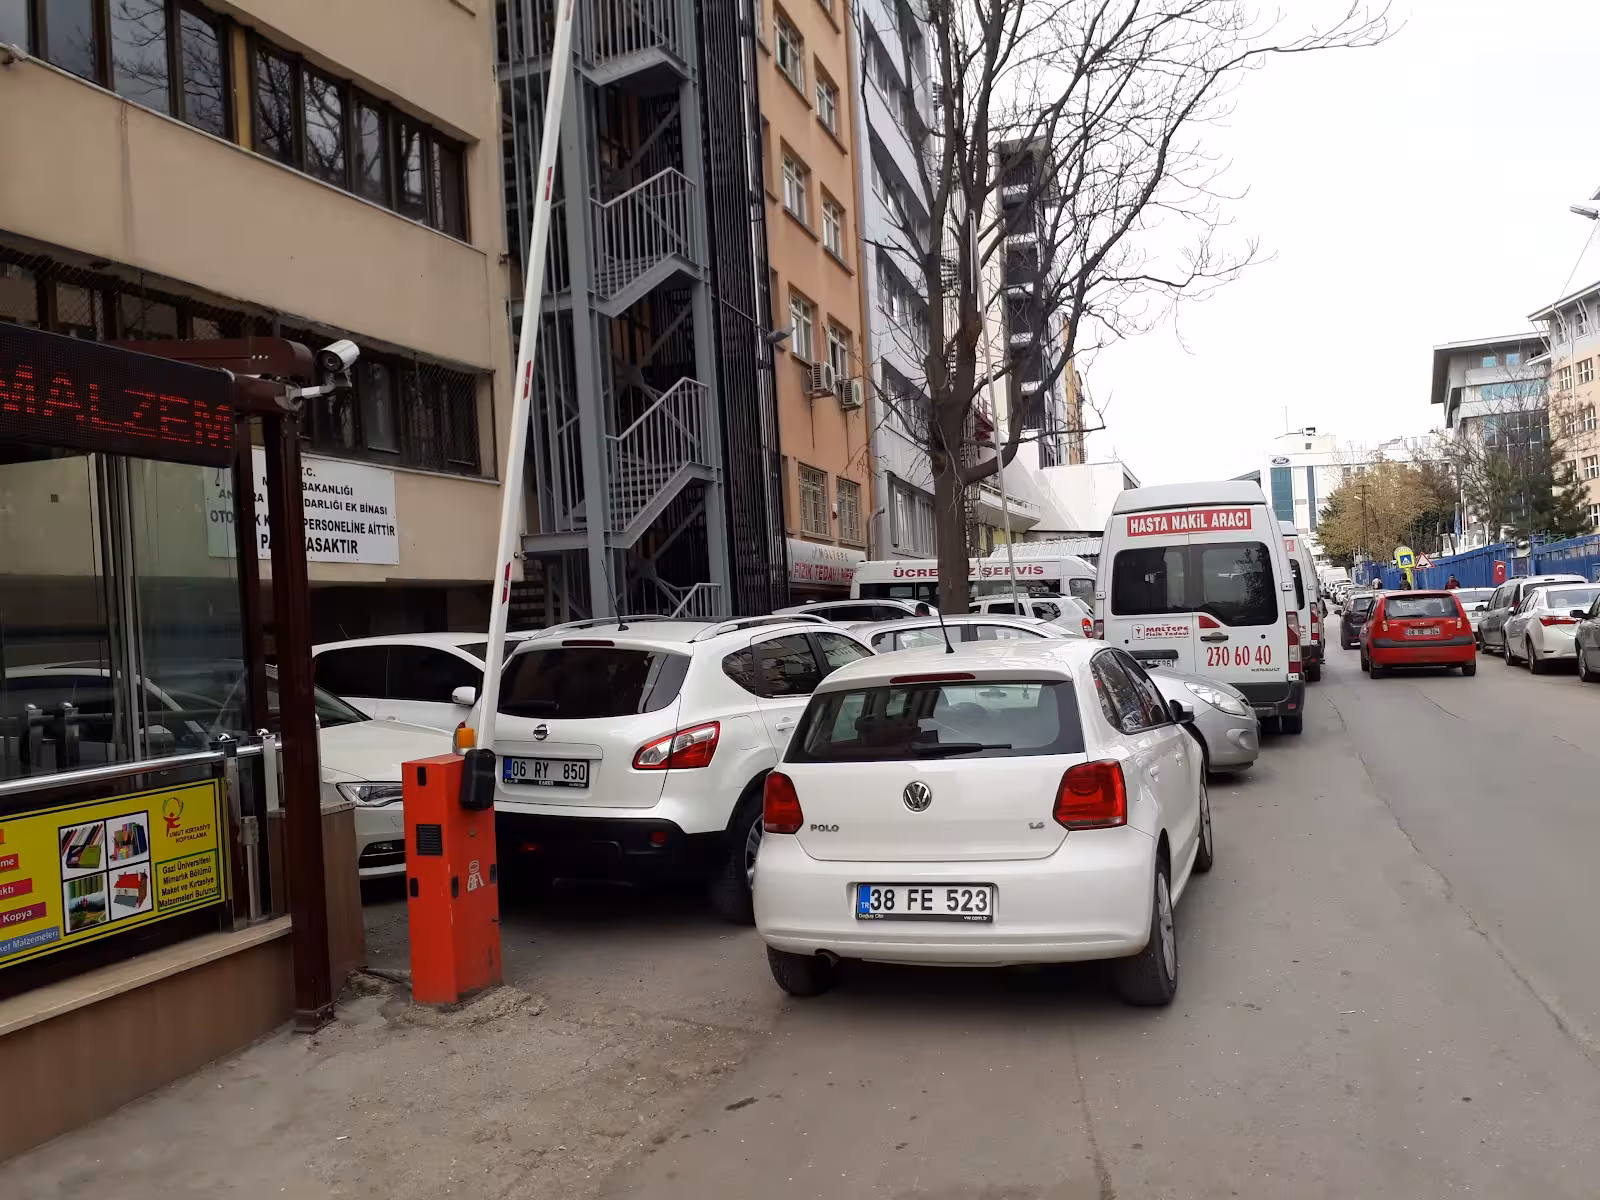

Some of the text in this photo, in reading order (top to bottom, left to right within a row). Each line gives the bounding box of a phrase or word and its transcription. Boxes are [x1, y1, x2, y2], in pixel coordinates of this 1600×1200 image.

[302, 481, 353, 496] BAKANLIĞI
[345, 502, 358, 513] EK
[359, 502, 388, 515] BİNASI
[304, 518, 366, 535] PERSONELİNE
[368, 521, 396, 537] AİTTİR
[1130, 518, 1169, 534] HASTA
[1211, 512, 1248, 528] ARACI
[305, 537, 359, 555] ASAKTIR
[1206, 644, 1272, 667] 230 60 40
[512, 761, 527, 777] 06
[535, 762, 549, 778] RY
[563, 763, 585, 780] 850
[809, 823, 840, 833] POLO
[162, 855, 211, 875] Gazi Üniversitesi
[189, 865, 212, 879] Bölümü
[159, 891, 194, 908] Malzemeleri
[161, 885, 180, 897] Maket
[860, 888, 987, 912] TR 38 FE 523
[2, 908, 33, 923] Kopya
[12, 928, 58, 949] Malzemeleri
